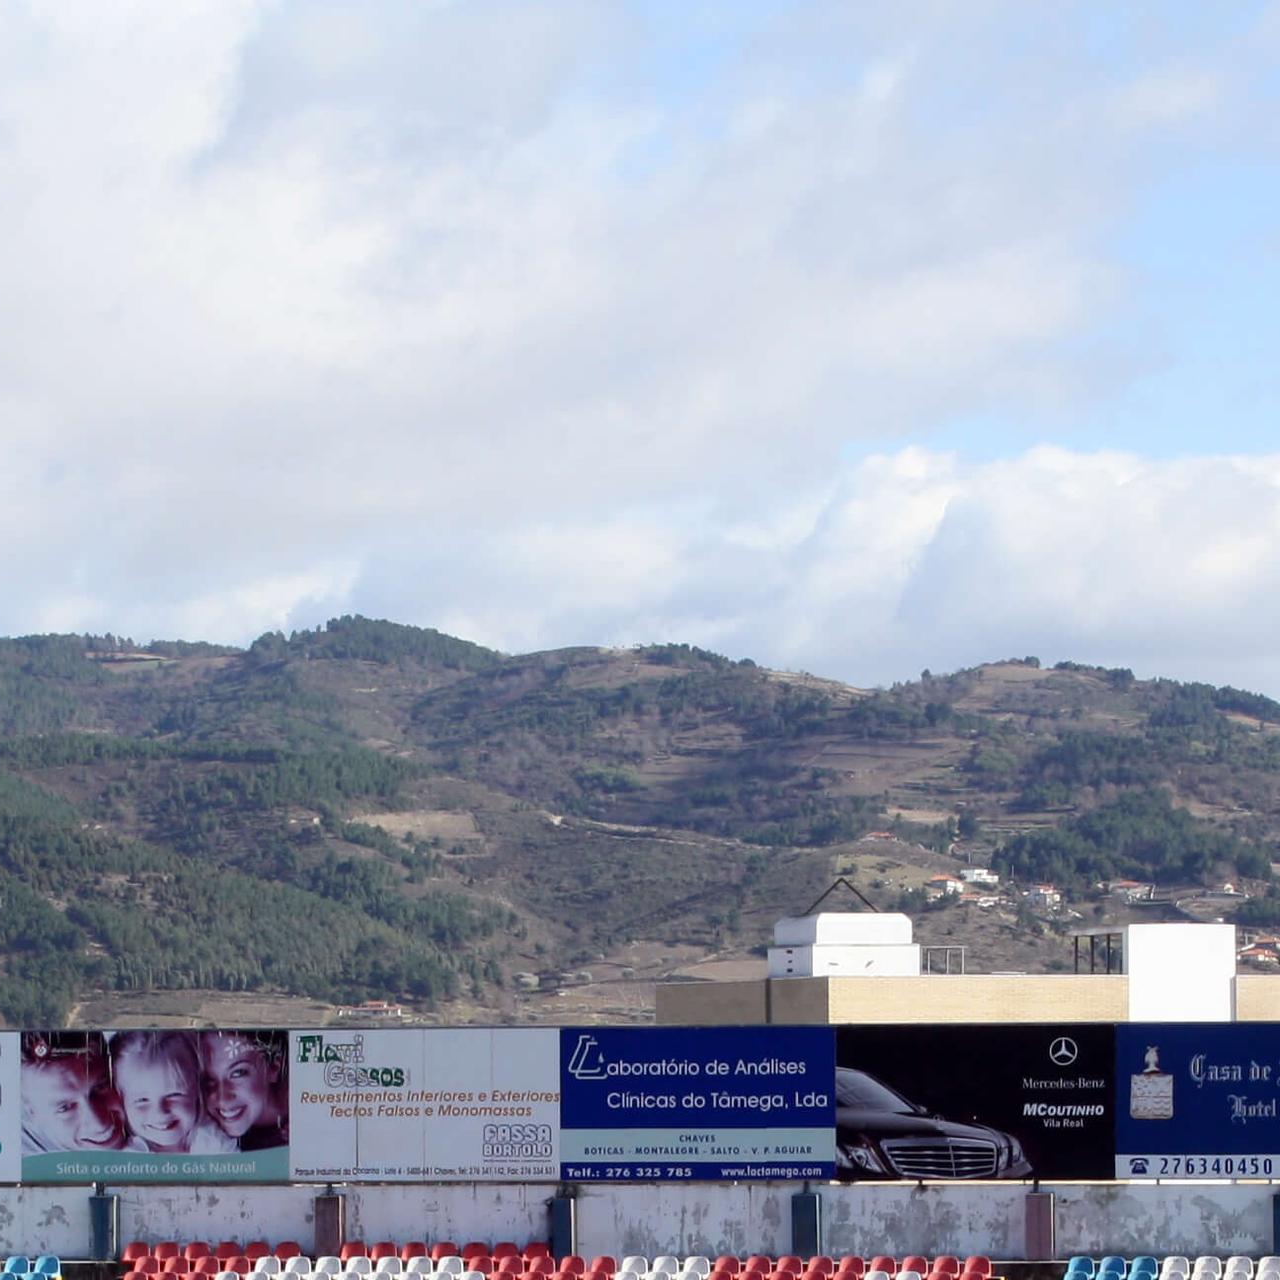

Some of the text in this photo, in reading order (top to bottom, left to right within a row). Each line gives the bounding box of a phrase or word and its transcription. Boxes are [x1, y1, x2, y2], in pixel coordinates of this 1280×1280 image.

[705, 1059, 730, 1076] de
[734, 1057, 806, 1076] Análises
[1189, 1053, 1242, 1088] Casa
[1248, 1060, 1272, 1081] de
[1022, 1077, 1105, 1089] Mercedes-Benz
[300, 1089, 561, 1104] Revestimentos Interiores e Exteriores
[607, 1090, 828, 1112] Clínicas do Tâmega, Lda
[329, 1104, 533, 1118] Tectos Falsos e Monomassas
[1227, 1094, 1276, 1125] Hotel
[1043, 1119, 1084, 1128] Vila Real
[679, 1134, 716, 1143] CHAVES
[584, 1147, 625, 1156] BOTICAS
[635, 1146, 699, 1155] MONTALEGRE
[710, 1146, 740, 1155] SALTO
[774, 1146, 812, 1154] AGUIAR
[56, 1162, 88, 1175] Sinta
[93, 1164, 100, 1174] o
[103, 1161, 158, 1175] conforto
[162, 1161, 178, 1174] do
[209, 1160, 256, 1174] Natural
[606, 1168, 631, 1177] 276
[636, 1168, 661, 1177] 325
[667, 1168, 692, 1177] 785
[1160, 1158, 1272, 1174] 276340450
